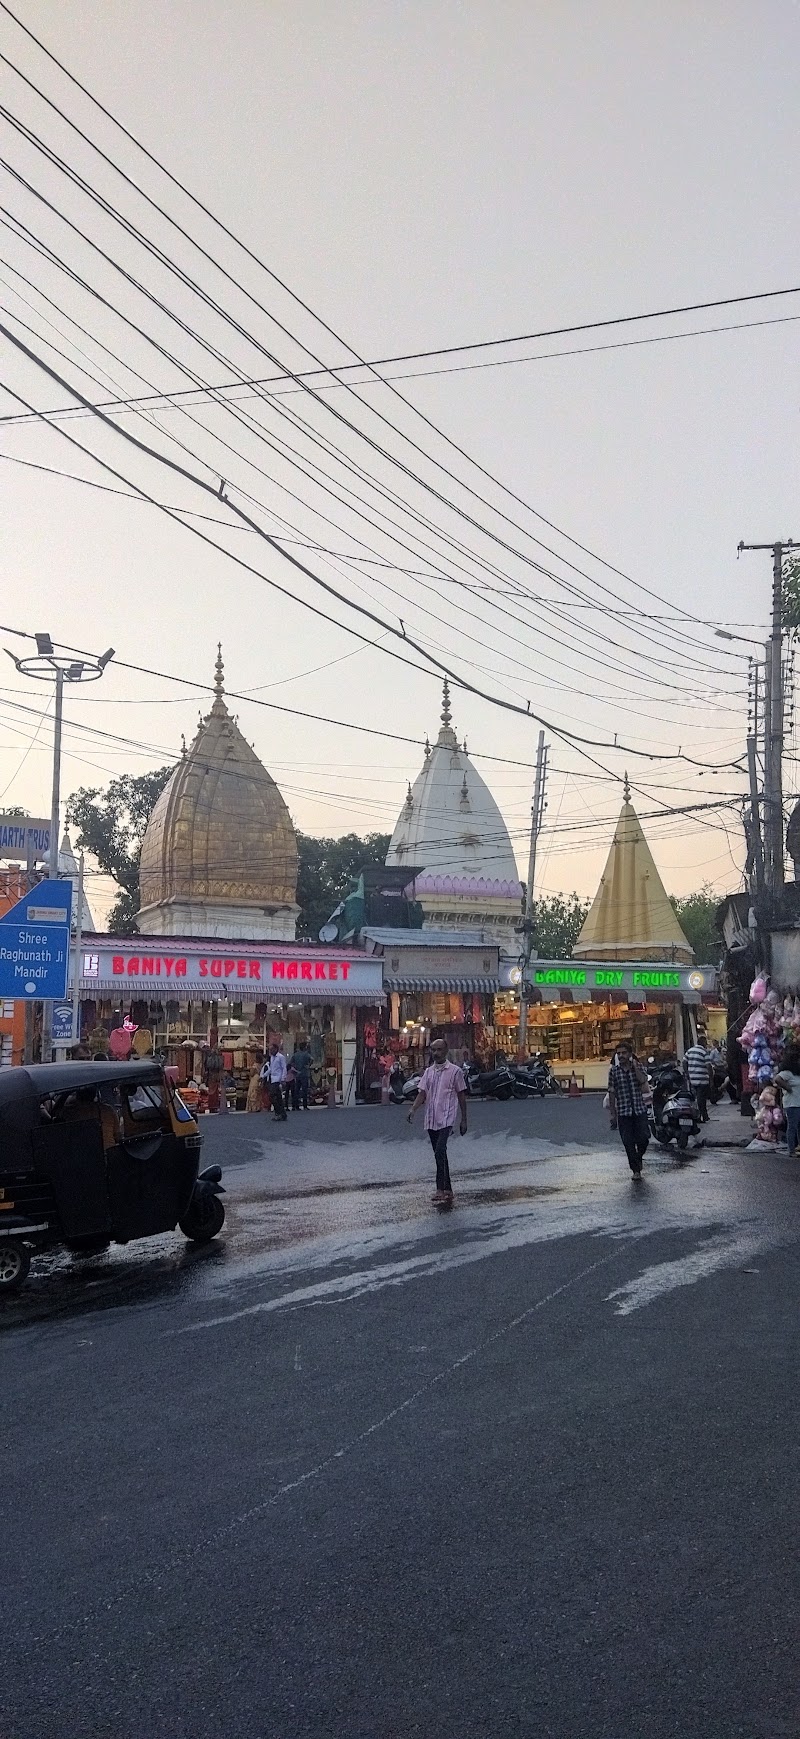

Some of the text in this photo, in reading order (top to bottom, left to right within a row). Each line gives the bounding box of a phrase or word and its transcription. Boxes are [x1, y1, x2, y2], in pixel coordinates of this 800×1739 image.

[0, 826, 25, 848] ARTH
[18, 931, 48, 944] Shree
[0, 947, 63, 962] Raghunath Ji
[14, 965, 48, 978] Mandir
[112, 956, 351, 981] BANIYA SUPER MARKET
[535, 968, 680, 988] BANIYA DRY FRUITS
